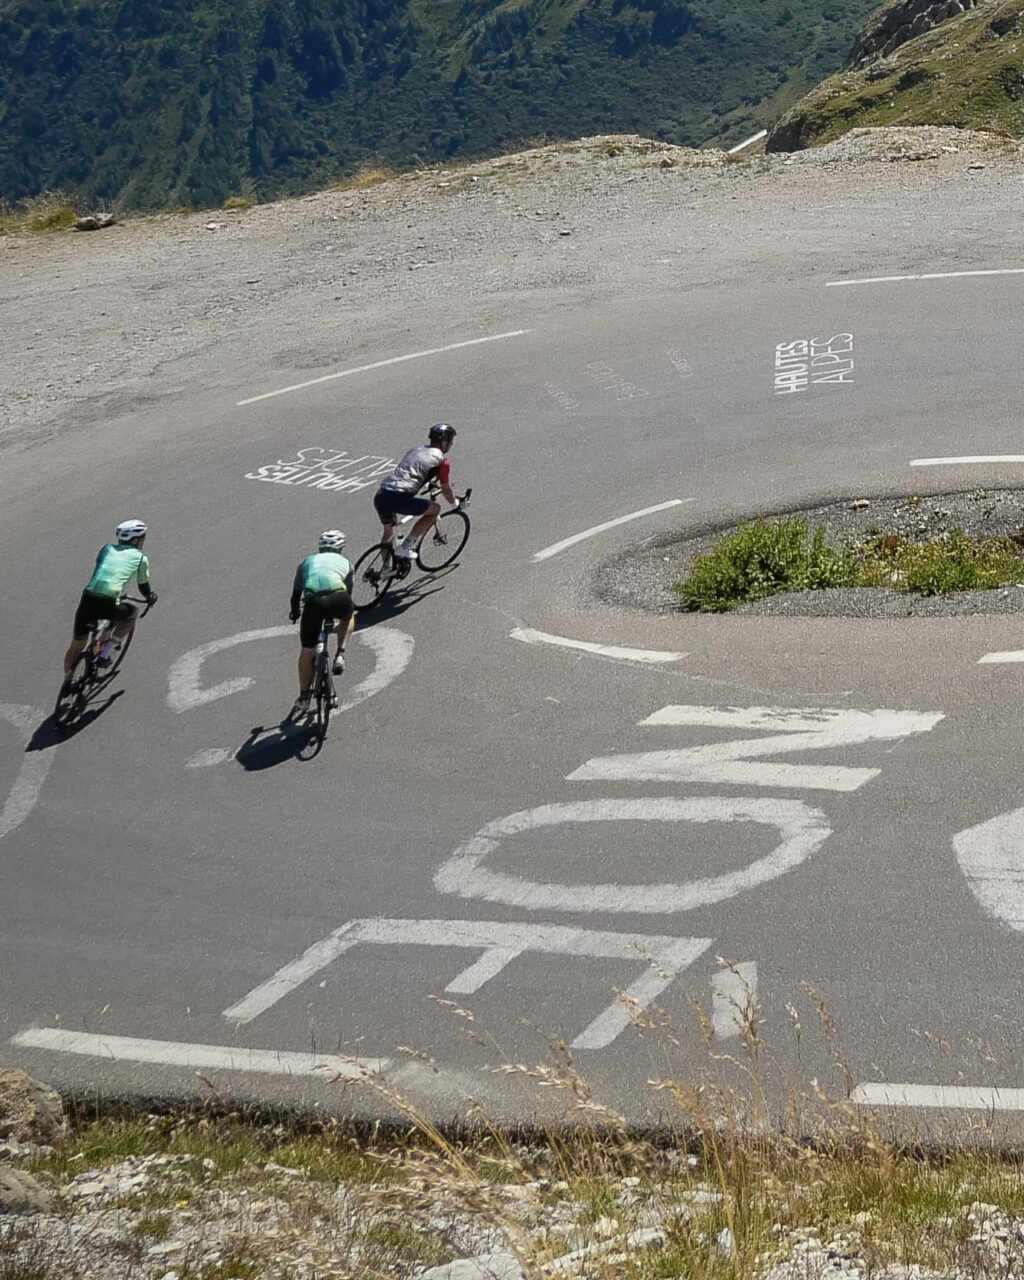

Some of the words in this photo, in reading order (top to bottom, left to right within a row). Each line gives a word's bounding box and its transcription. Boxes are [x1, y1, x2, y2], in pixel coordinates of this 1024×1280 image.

[774, 340, 808, 395] HAUTES
[810, 333, 854, 383] ALPES
[244, 465, 377, 494] HAUTES
[277, 447, 398, 478] ALPES
